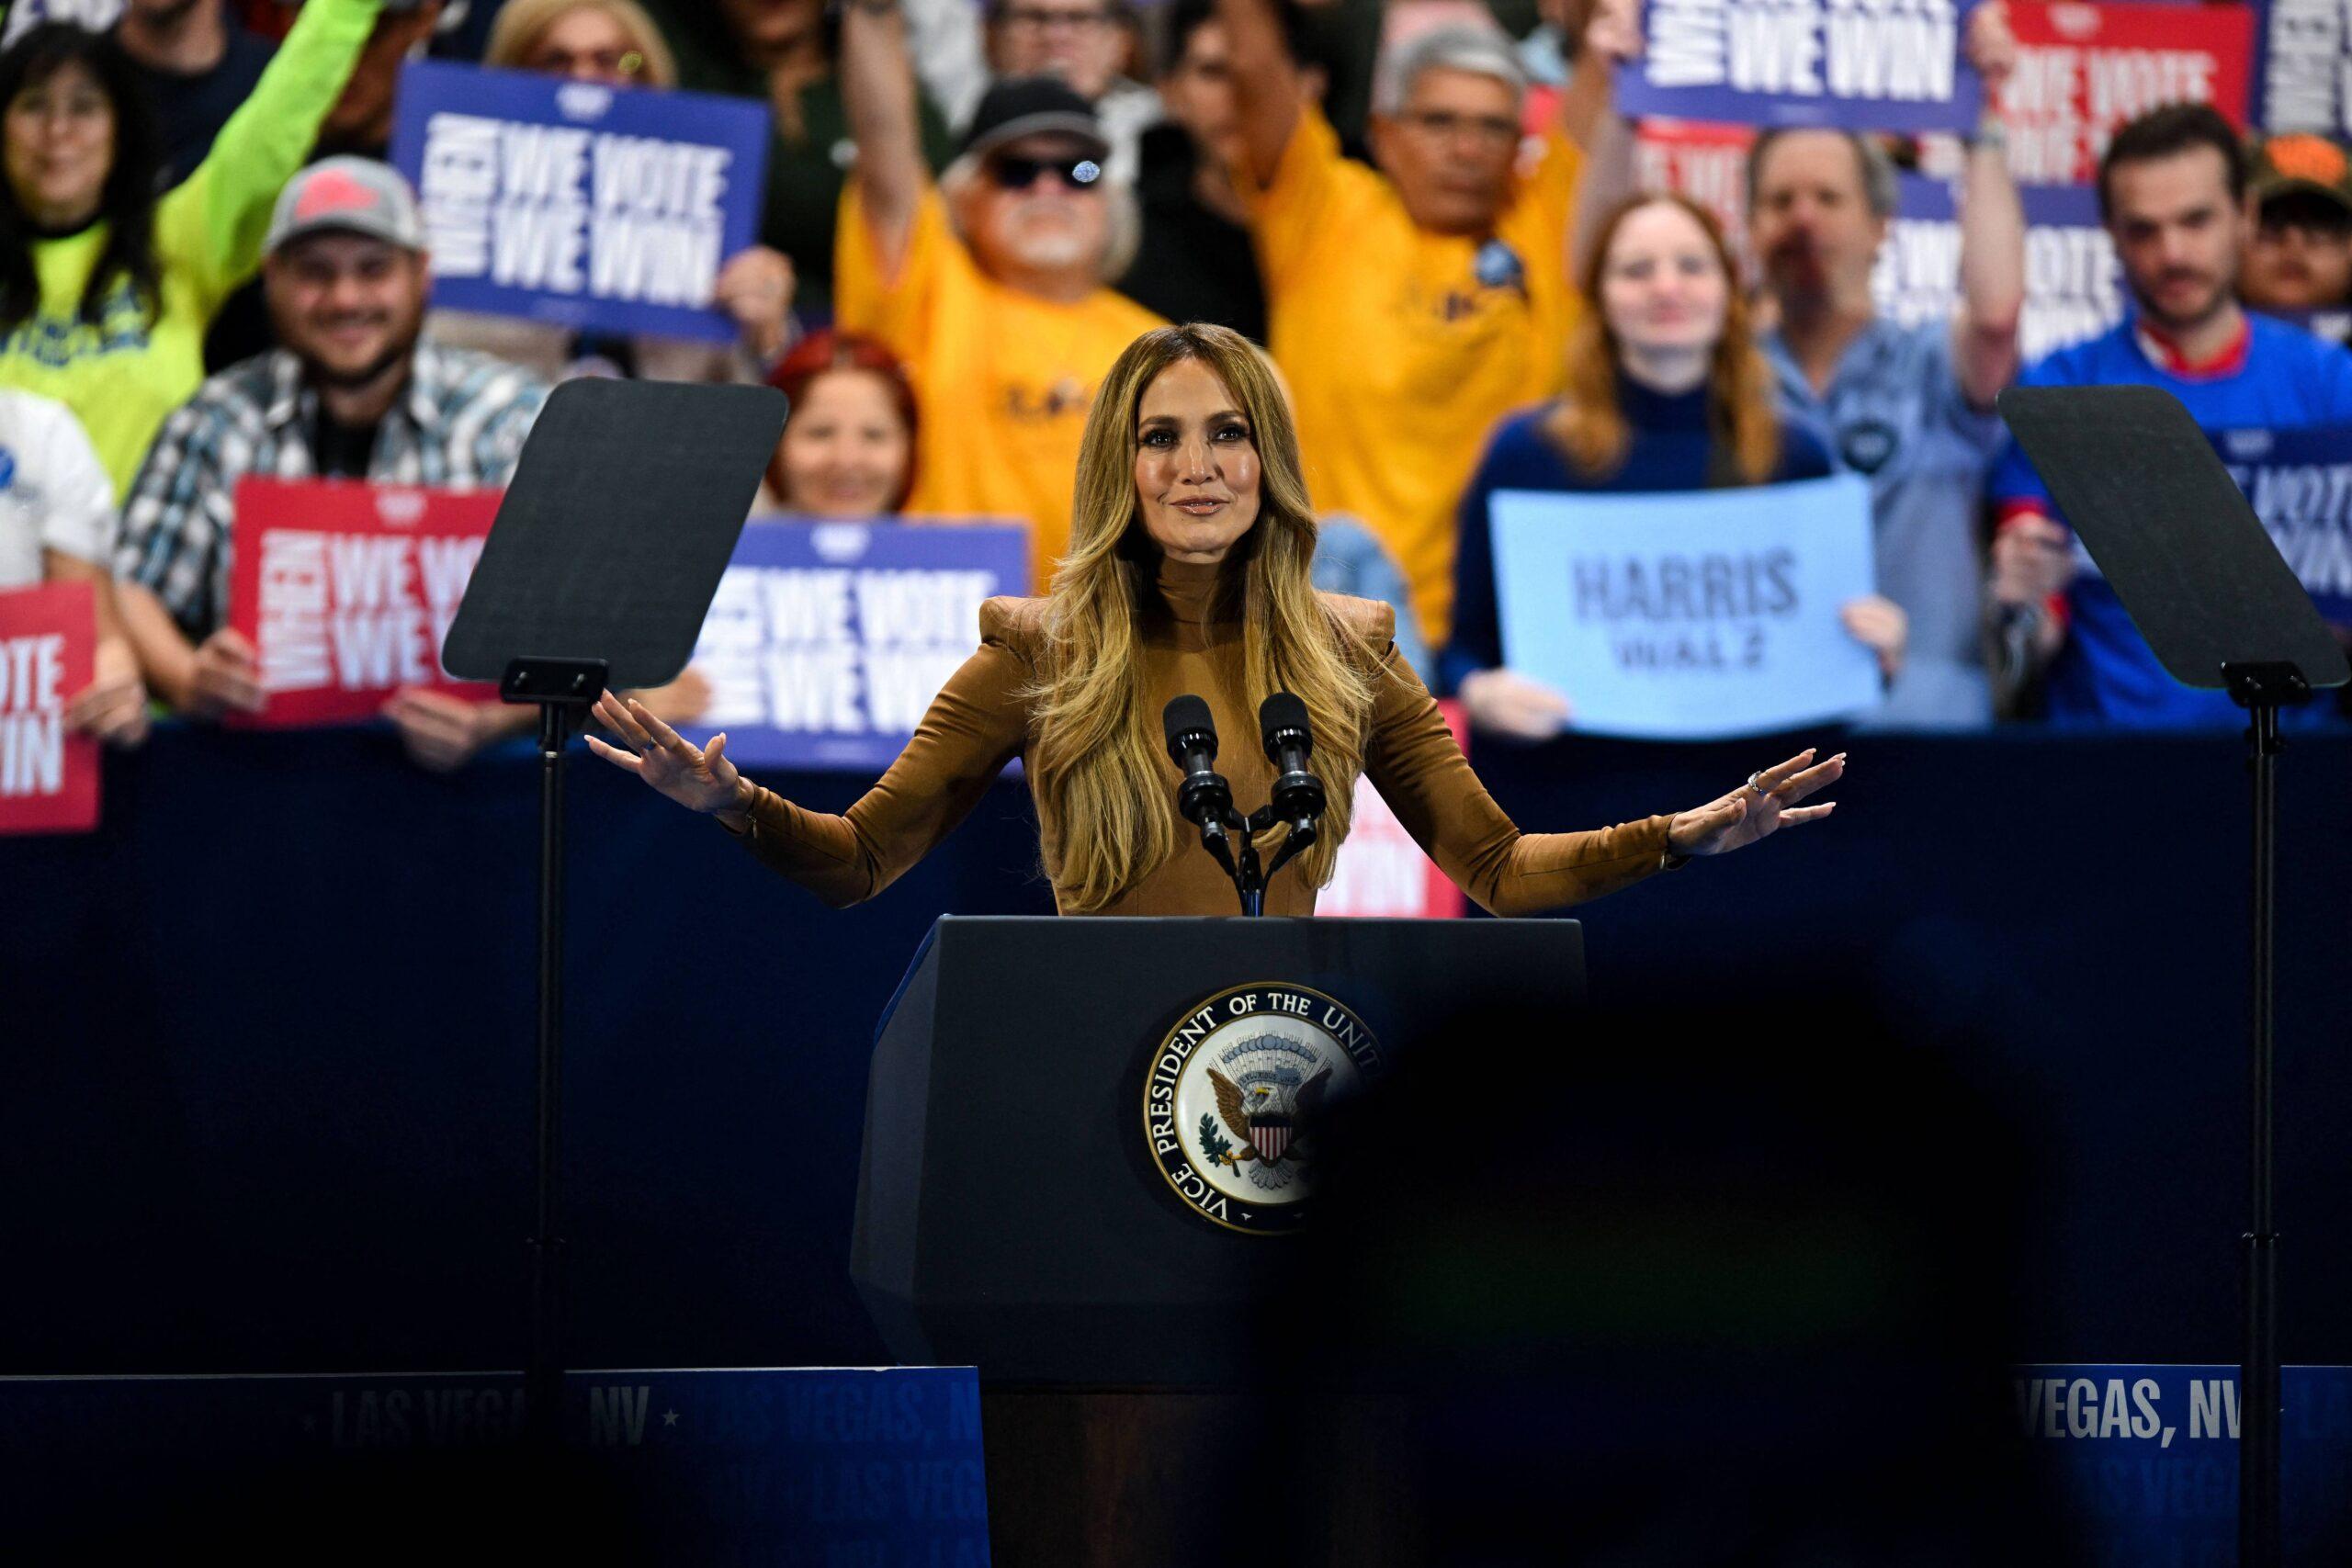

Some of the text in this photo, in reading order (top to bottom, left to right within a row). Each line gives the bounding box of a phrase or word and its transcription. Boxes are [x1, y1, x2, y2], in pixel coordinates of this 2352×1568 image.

[1728, 9, 1825, 95] WE
[1826, 13, 1957, 102] WIN
[499, 120, 733, 220] WE VOTE
[492, 197, 726, 310] WE WIN
[329, 531, 417, 606] WE
[763, 567, 850, 643] WE
[1573, 548, 1799, 623] HARRIS
[333, 608, 430, 689] WE
[768, 648, 865, 732] WE
[1229, 994, 1257, 1015] OF
[1268, 992, 1311, 1016] THE
[1150, 1007, 1218, 1156] PRESIDENT
[1171, 1163, 1228, 1222] VICE
[331, 1389, 413, 1449] LAS
[589, 1385, 650, 1446] NV
[2014, 1378, 2177, 1449] VEGAS,
